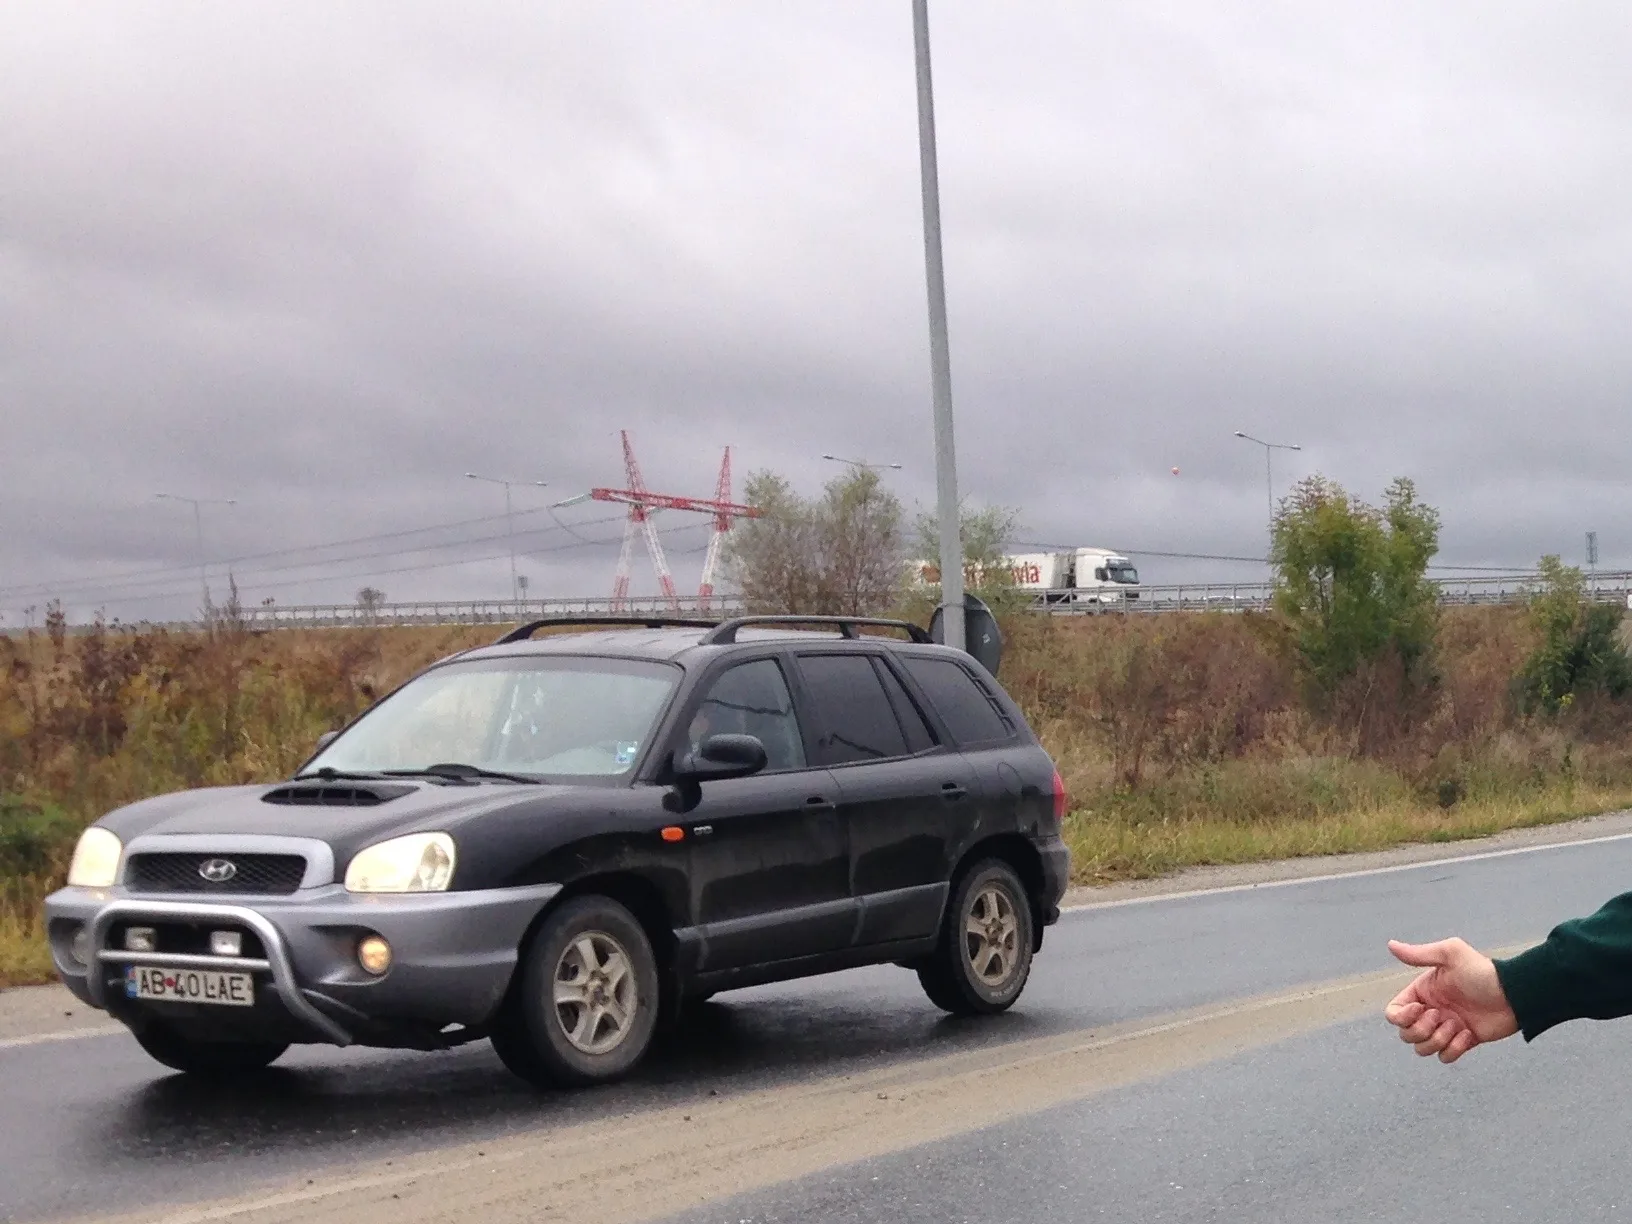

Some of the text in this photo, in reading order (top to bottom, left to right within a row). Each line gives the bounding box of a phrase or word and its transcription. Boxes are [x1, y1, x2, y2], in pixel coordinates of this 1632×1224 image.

[140, 969, 246, 1001] AB 40 LAE
